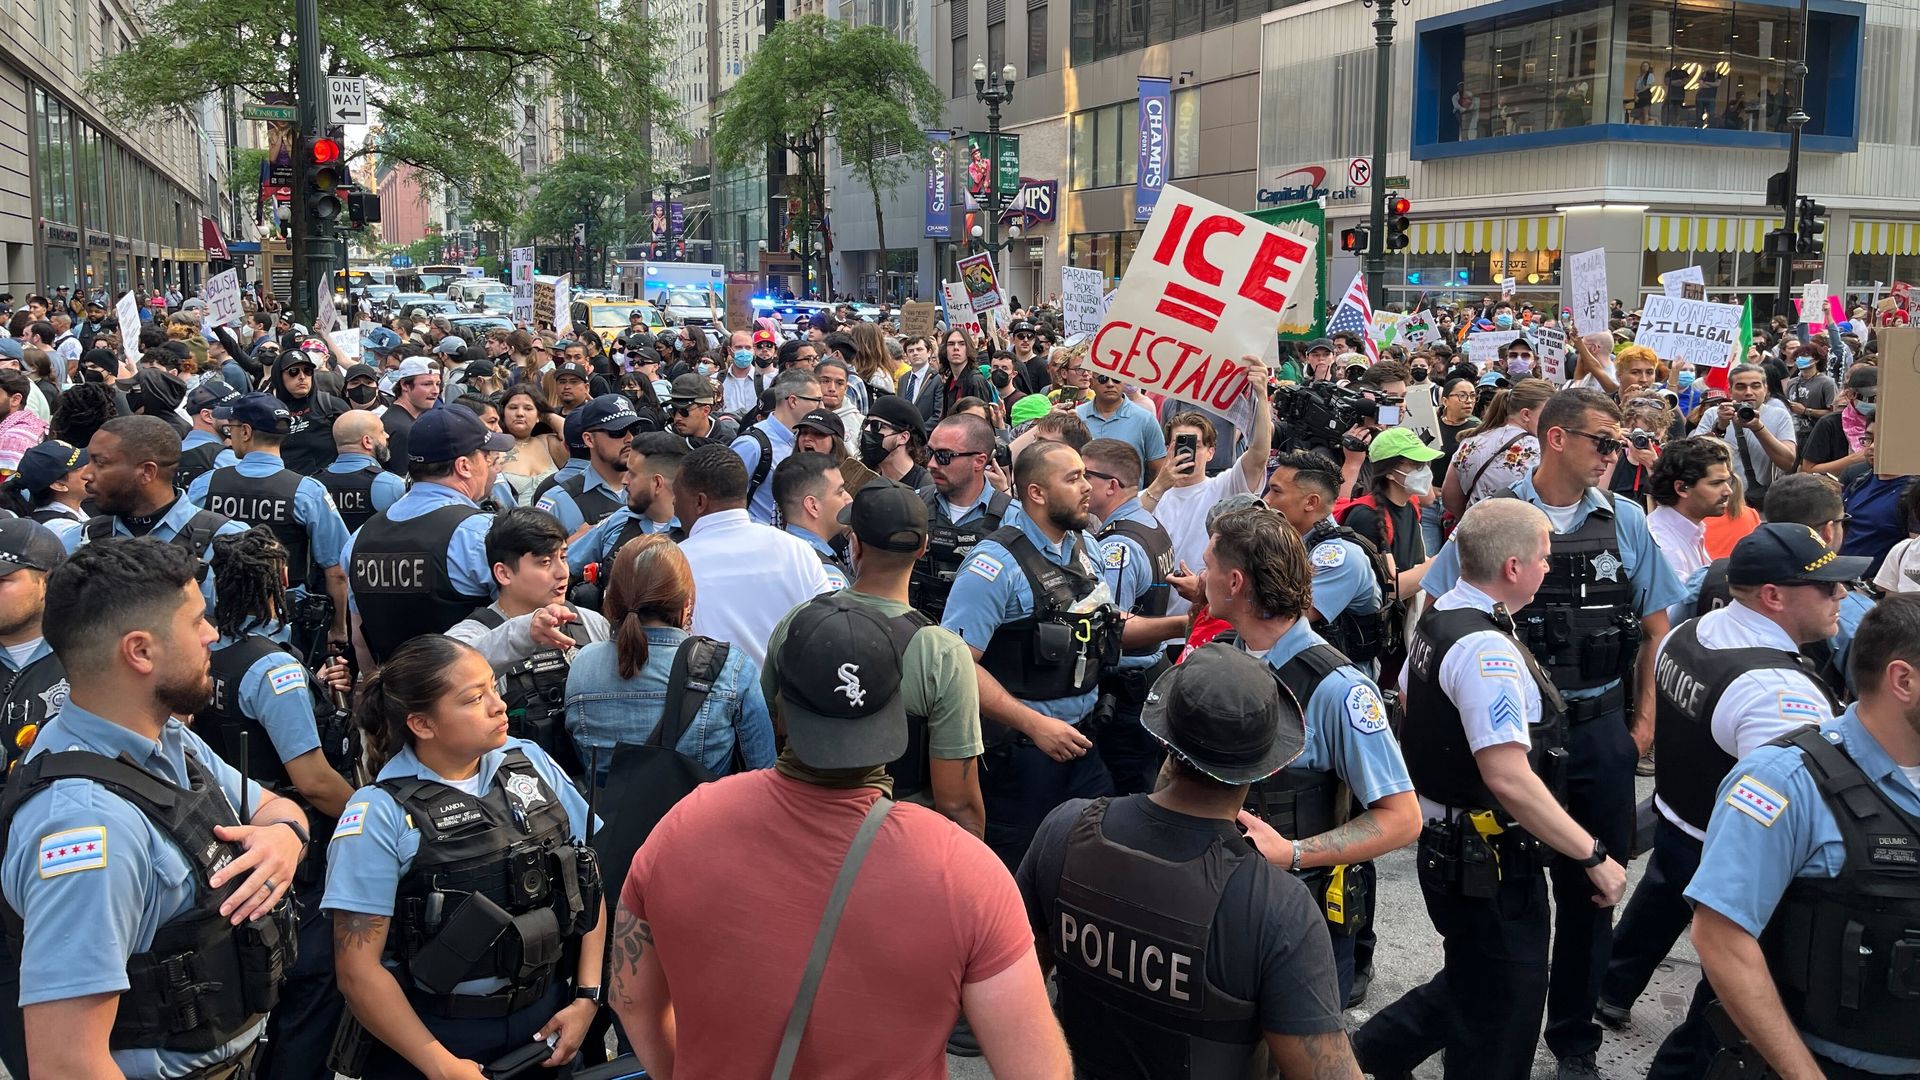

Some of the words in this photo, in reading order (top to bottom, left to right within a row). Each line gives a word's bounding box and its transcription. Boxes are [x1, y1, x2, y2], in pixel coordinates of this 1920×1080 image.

[332, 81, 360, 93] ONE
[332, 94, 361, 106] WAY
[1145, 99, 1163, 188] CHAMPS
[931, 145, 947, 213] CHAMPS
[1025, 185, 1051, 214] MPS
[1137, 205, 1155, 214] CHA
[1153, 203, 1308, 314] ICE
[1073, 282, 1096, 295] PADRES
[212, 295, 237, 321] ICE
[1065, 302, 1077, 312] CON
[1080, 306, 1097, 315] NADA
[1646, 297, 1674, 319] NO
[1677, 302, 1716, 326] ONE
[1715, 306, 1742, 329] IS
[1065, 320, 1078, 331] ME
[1080, 322, 1100, 332] DIERO
[1539, 329, 1546, 337] NO
[1547, 330, 1564, 341] HUMAN
[1655, 321, 1733, 345] ILLEGAL
[1546, 339, 1563, 350] ILLEGAL
[1640, 332, 1664, 353] ON
[1090, 320, 1249, 411] GESTAPO
[1543, 356, 1559, 366] STOLEN
[211, 495, 286, 521] POLICE
[340, 491, 365, 509] ICE
[357, 558, 425, 588] POLICE
[1656, 652, 1706, 714] POLICE
[1359, 713, 1386, 729] POLICE
[440, 802, 465, 813] LANDA
[1061, 911, 1192, 1001] POLICE
